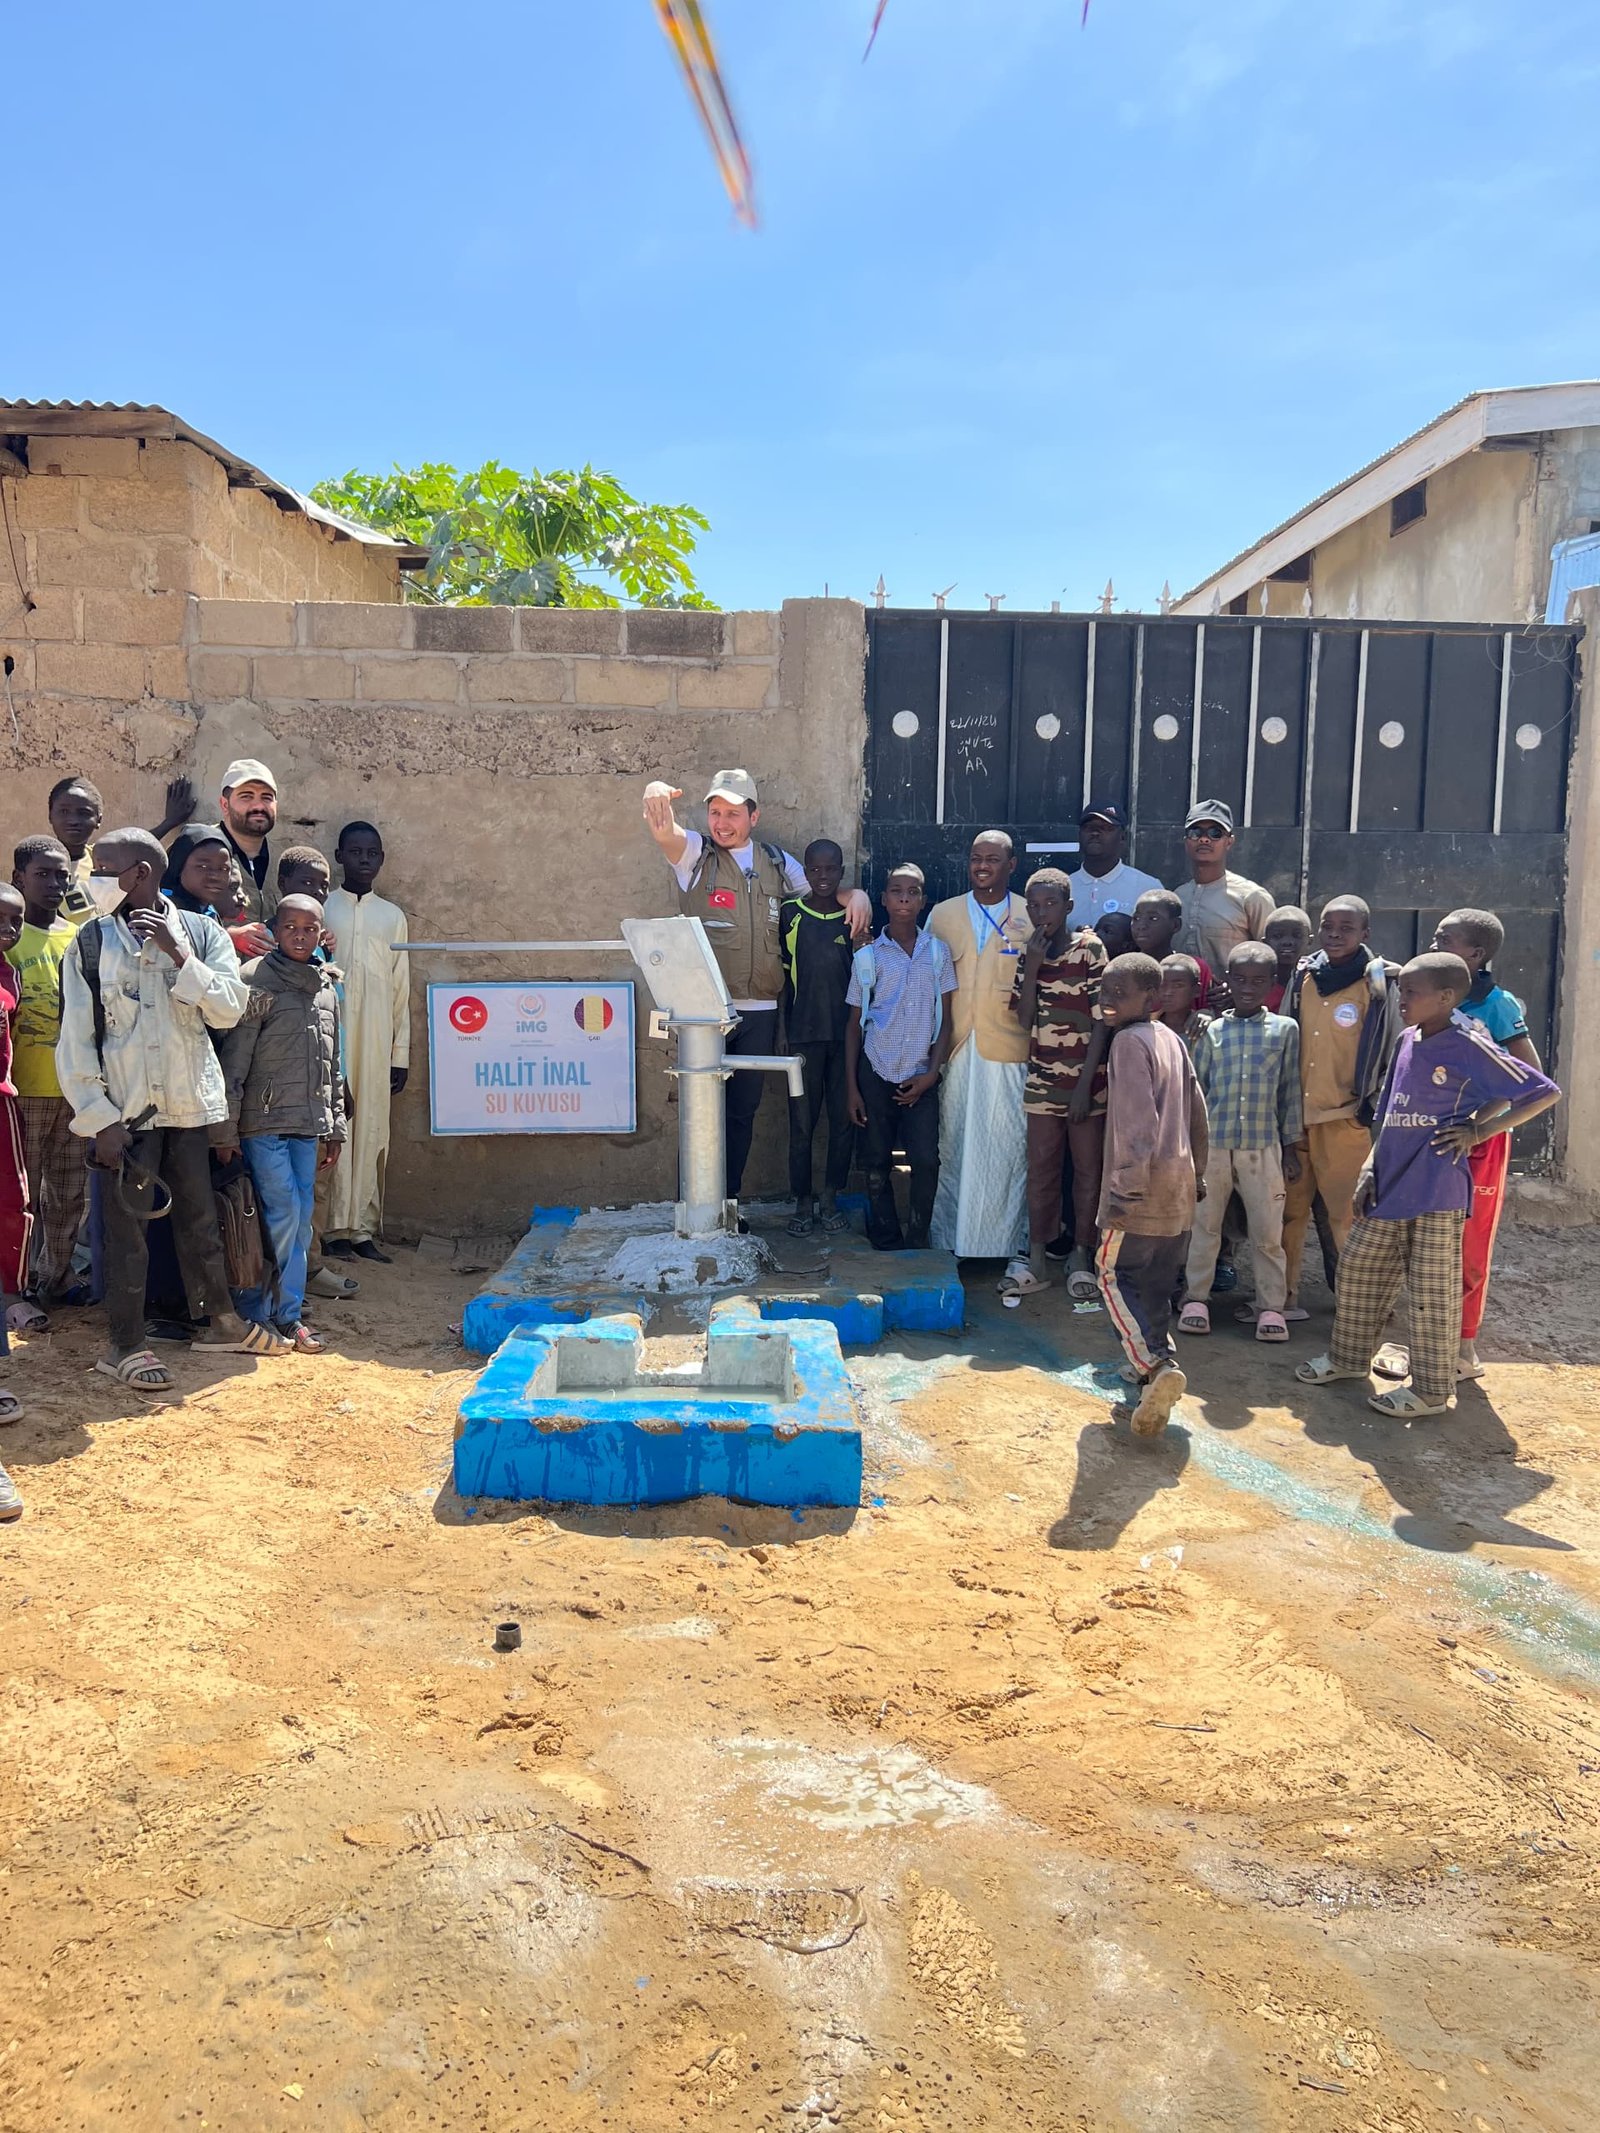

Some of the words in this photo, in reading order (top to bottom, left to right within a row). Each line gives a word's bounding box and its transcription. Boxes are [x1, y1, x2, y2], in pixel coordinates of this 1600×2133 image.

[475, 1056, 537, 1087] HALİT
[543, 1056, 591, 1086] İNAL
[486, 1093, 508, 1114] SU
[513, 1092, 582, 1114] KUYUSU
